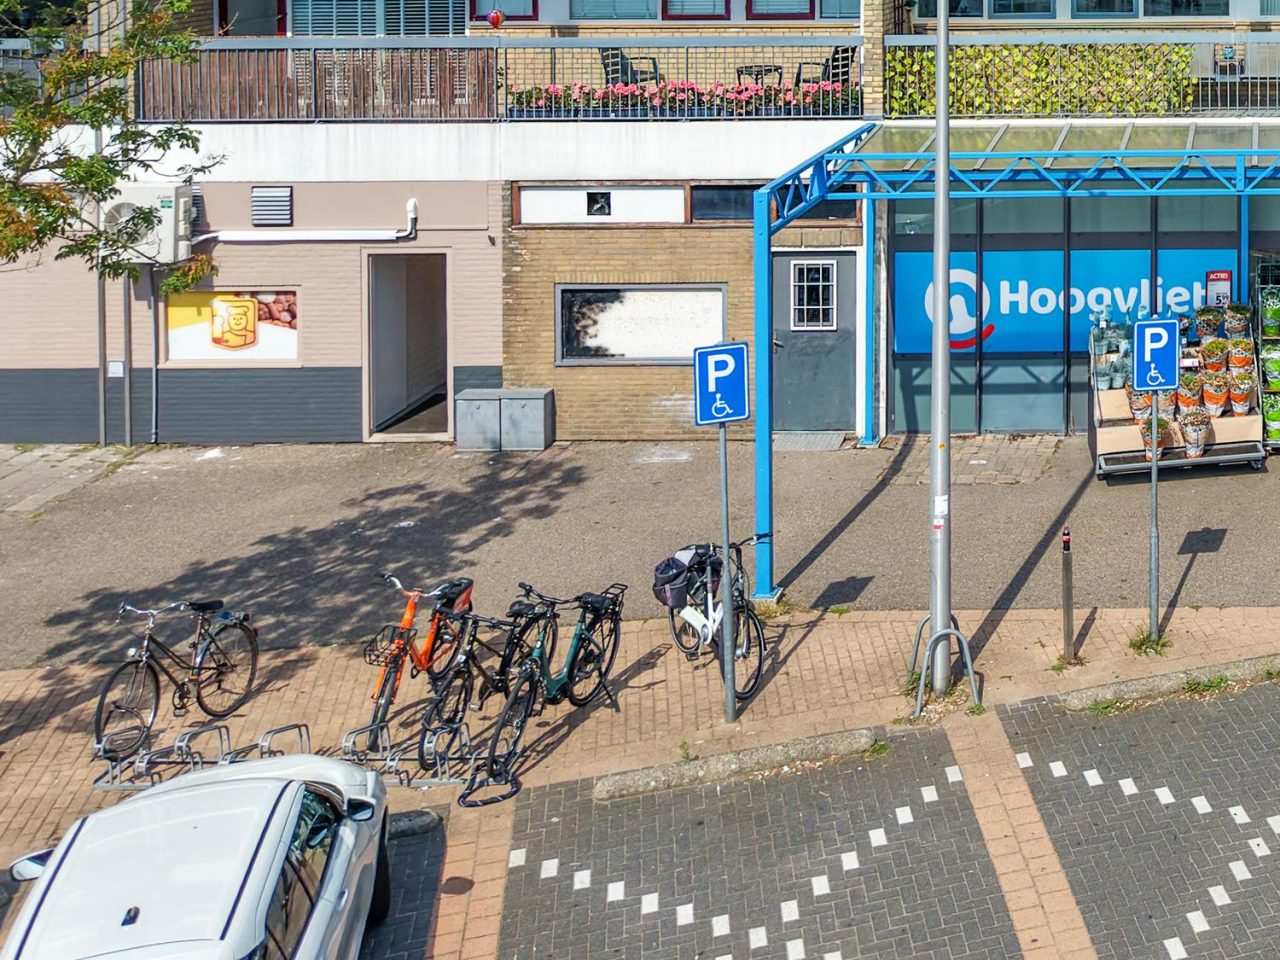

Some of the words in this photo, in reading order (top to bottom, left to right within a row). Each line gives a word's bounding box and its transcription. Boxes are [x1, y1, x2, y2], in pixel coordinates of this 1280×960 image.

[1000, 276, 1208, 323] Hoogvliet
[1144, 327, 1169, 362] P
[707, 354, 736, 392] P
